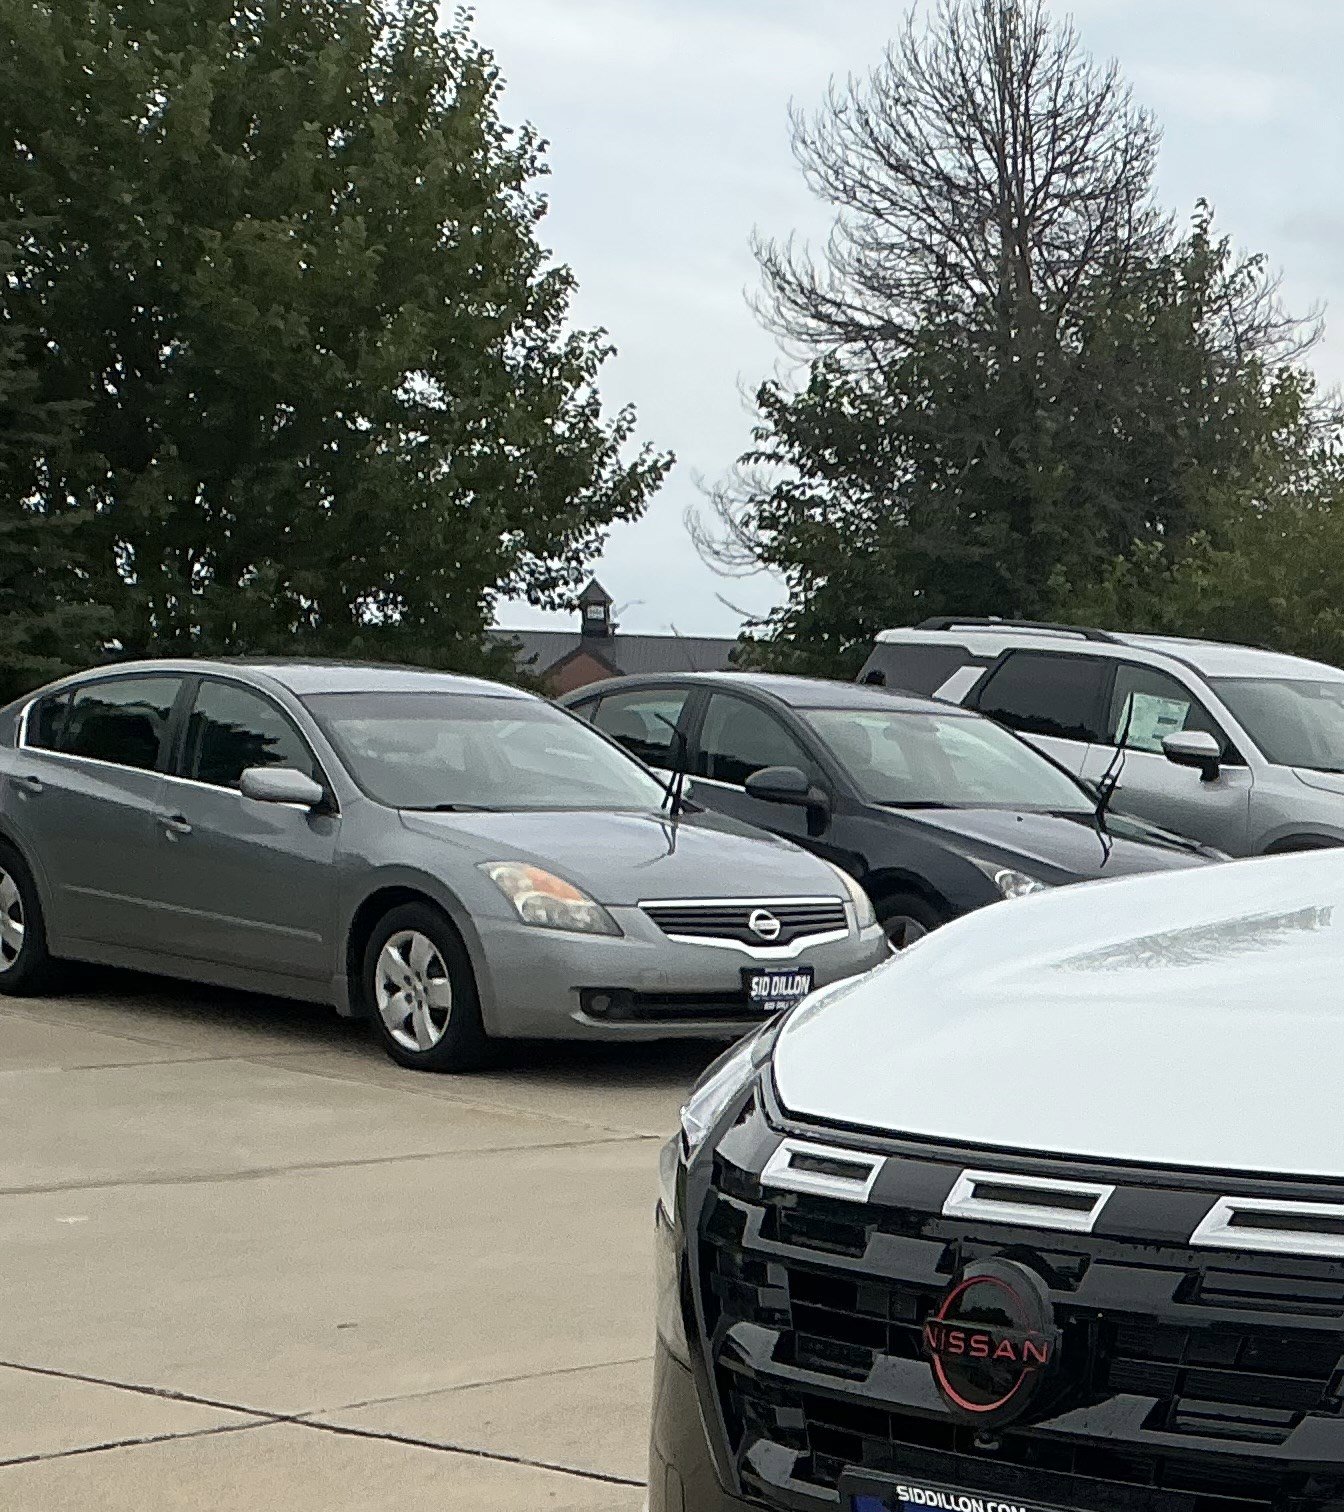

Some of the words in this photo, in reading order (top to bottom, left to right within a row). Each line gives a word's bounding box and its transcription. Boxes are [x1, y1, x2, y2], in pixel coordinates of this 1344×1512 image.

[751, 975, 770, 997] SID
[771, 974, 811, 996] DILLON
[925, 1324, 1048, 1363] NISSAN
